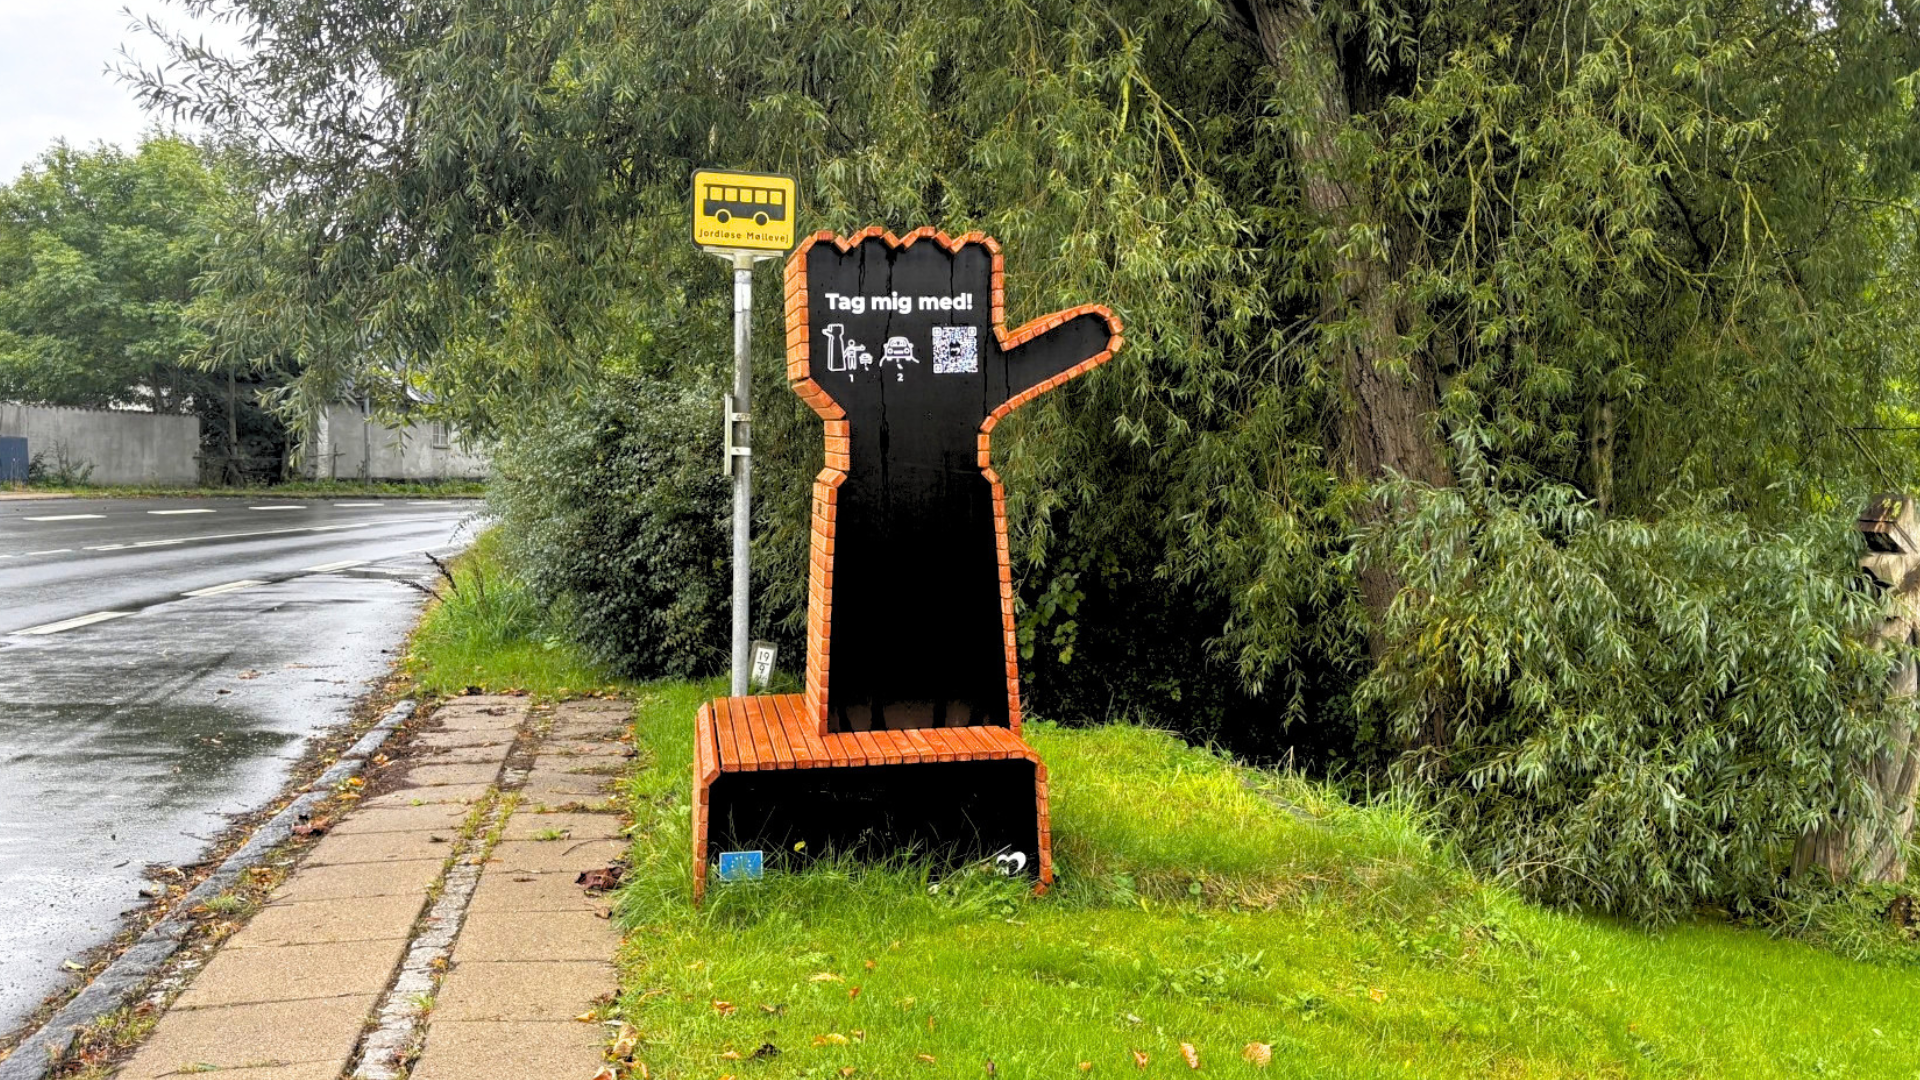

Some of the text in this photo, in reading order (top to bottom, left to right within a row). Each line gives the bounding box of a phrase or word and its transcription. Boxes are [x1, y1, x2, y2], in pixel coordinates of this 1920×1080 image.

[698, 228, 789, 243] Jordløse Møllevej
[825, 291, 973, 314] Tag mig med!
[848, 374, 854, 383] 1
[896, 373, 904, 382] 2
[759, 651, 770, 662] 19
